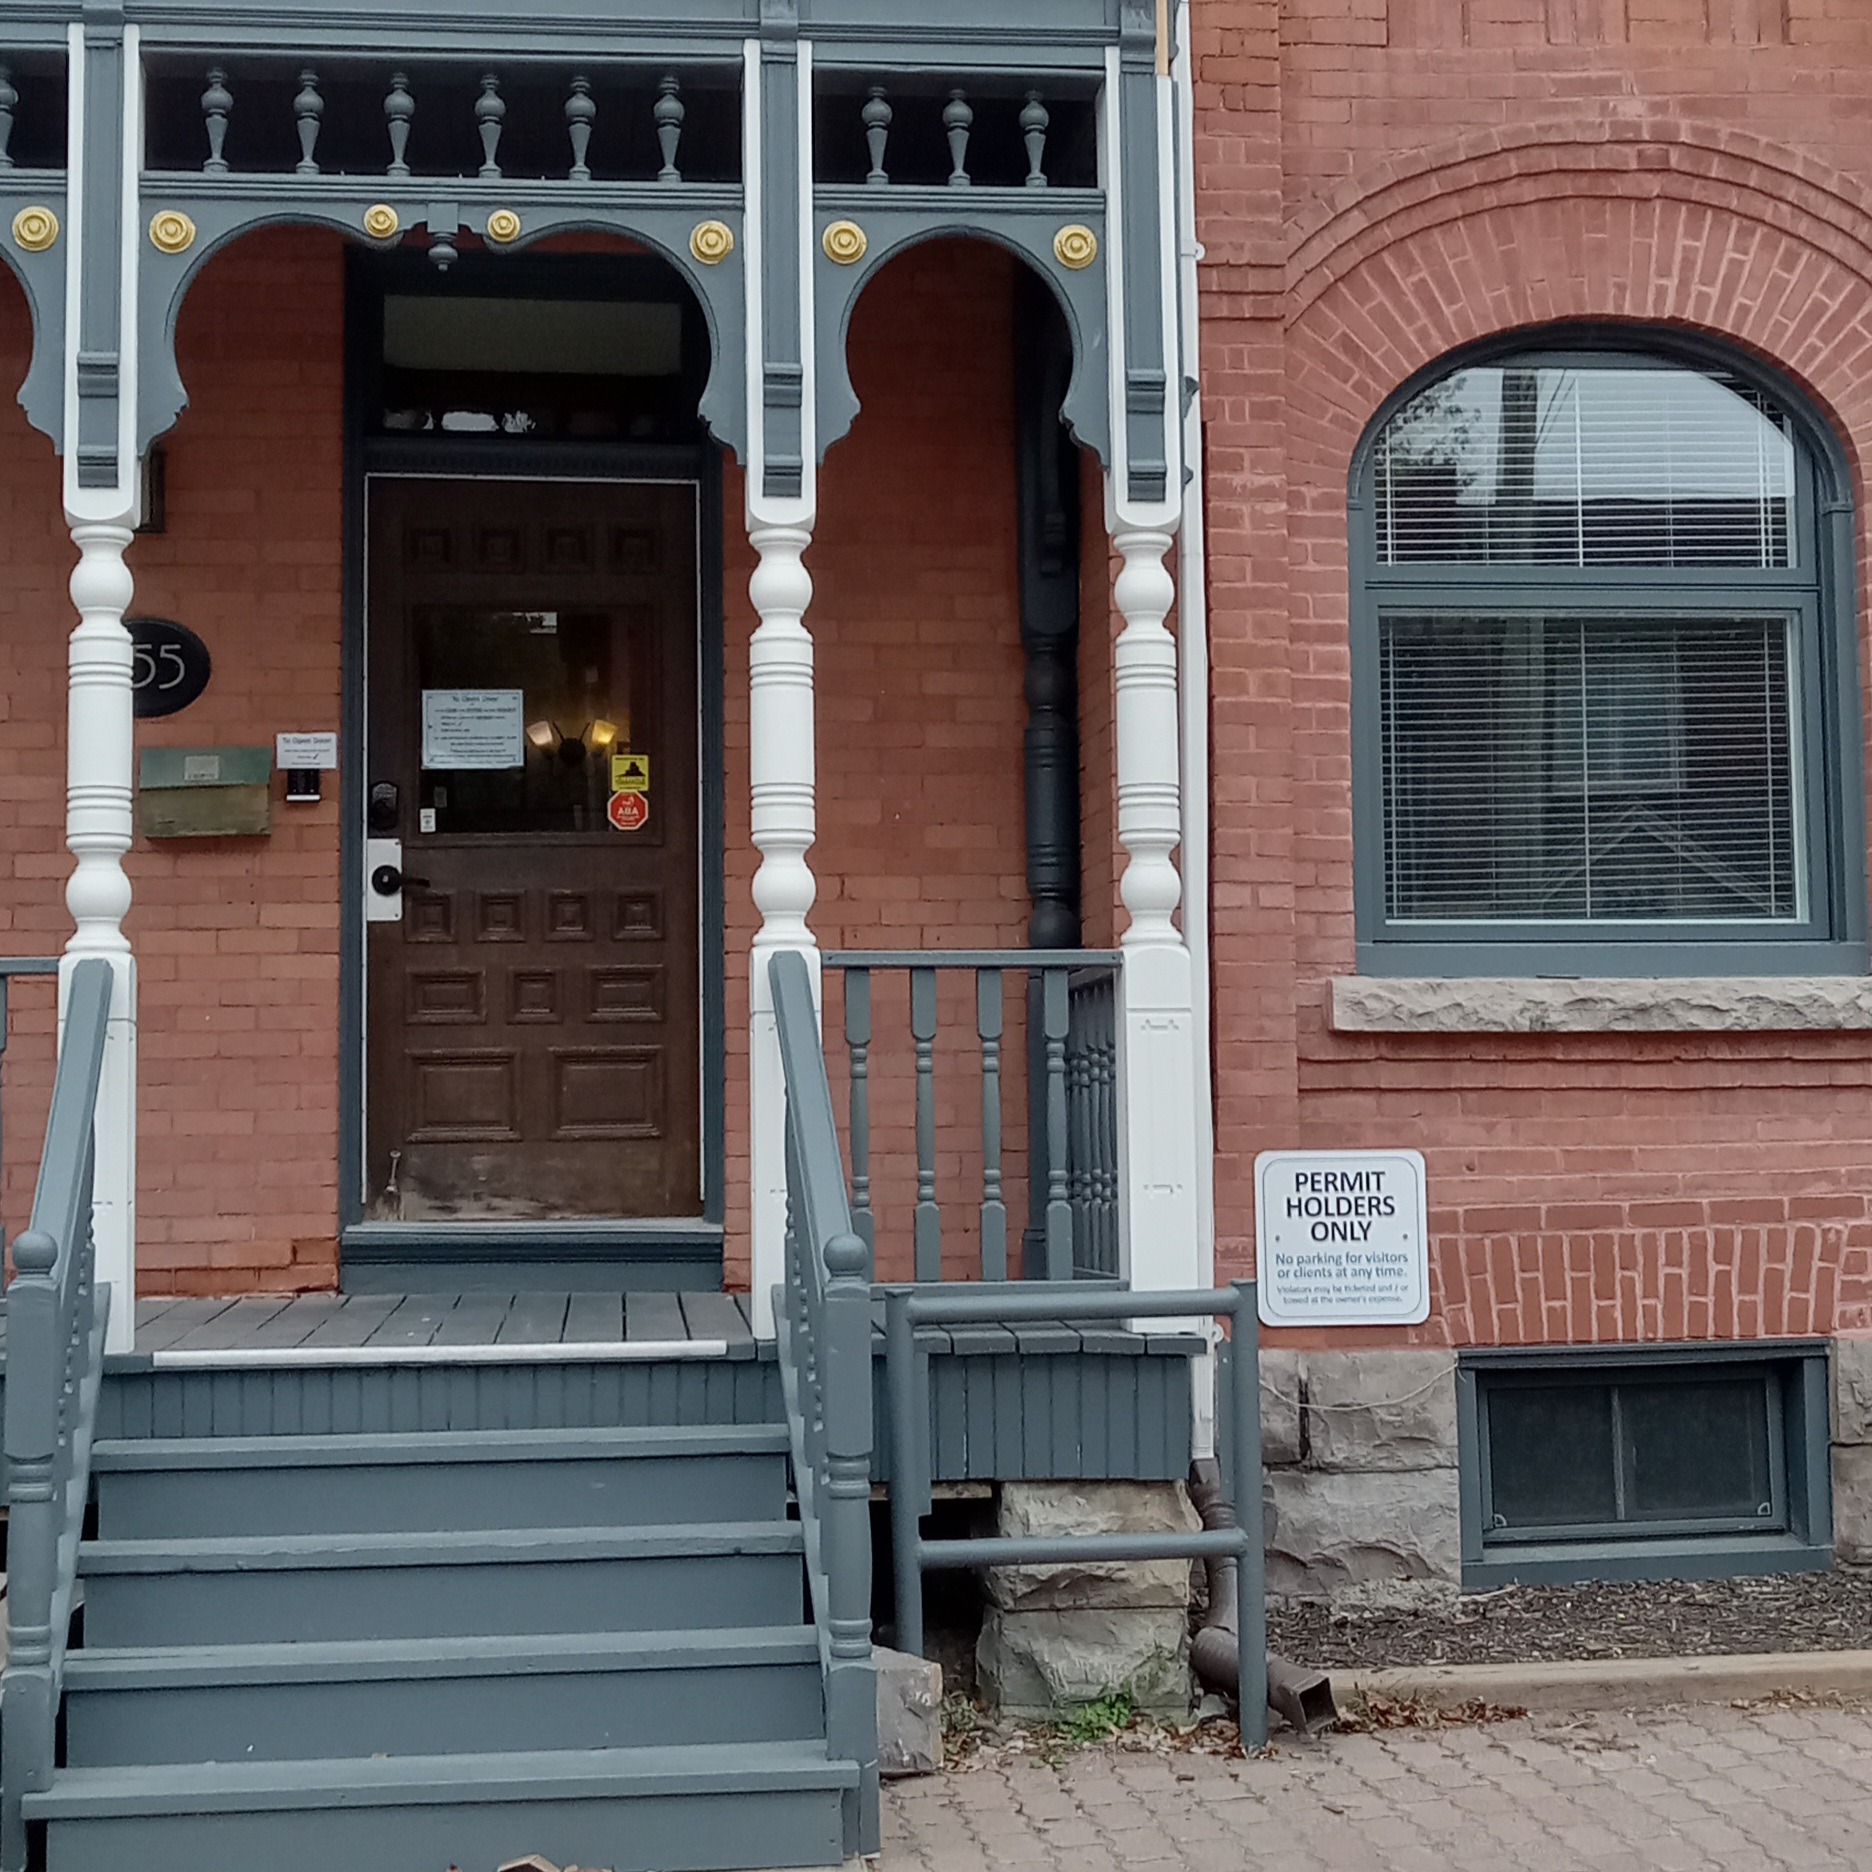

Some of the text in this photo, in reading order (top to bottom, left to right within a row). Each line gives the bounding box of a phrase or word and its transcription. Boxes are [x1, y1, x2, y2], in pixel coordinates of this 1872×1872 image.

[1295, 1171, 1385, 1192] PERMIT
[1286, 1196, 1395, 1217] HOLDERS
[1311, 1221, 1372, 1242] ONLY
[1276, 1251, 1408, 1266] No parking for visitors
[1278, 1266, 1407, 1280] or clients at any time.
[1277, 1285, 1311, 1294] Violators
[1314, 1286, 1330, 1295] may
[1332, 1284, 1342, 1293] be
[1345, 1284, 1375, 1292] ticketed
[1378, 1284, 1392, 1292] and
[1283, 1295, 1308, 1304] towed
